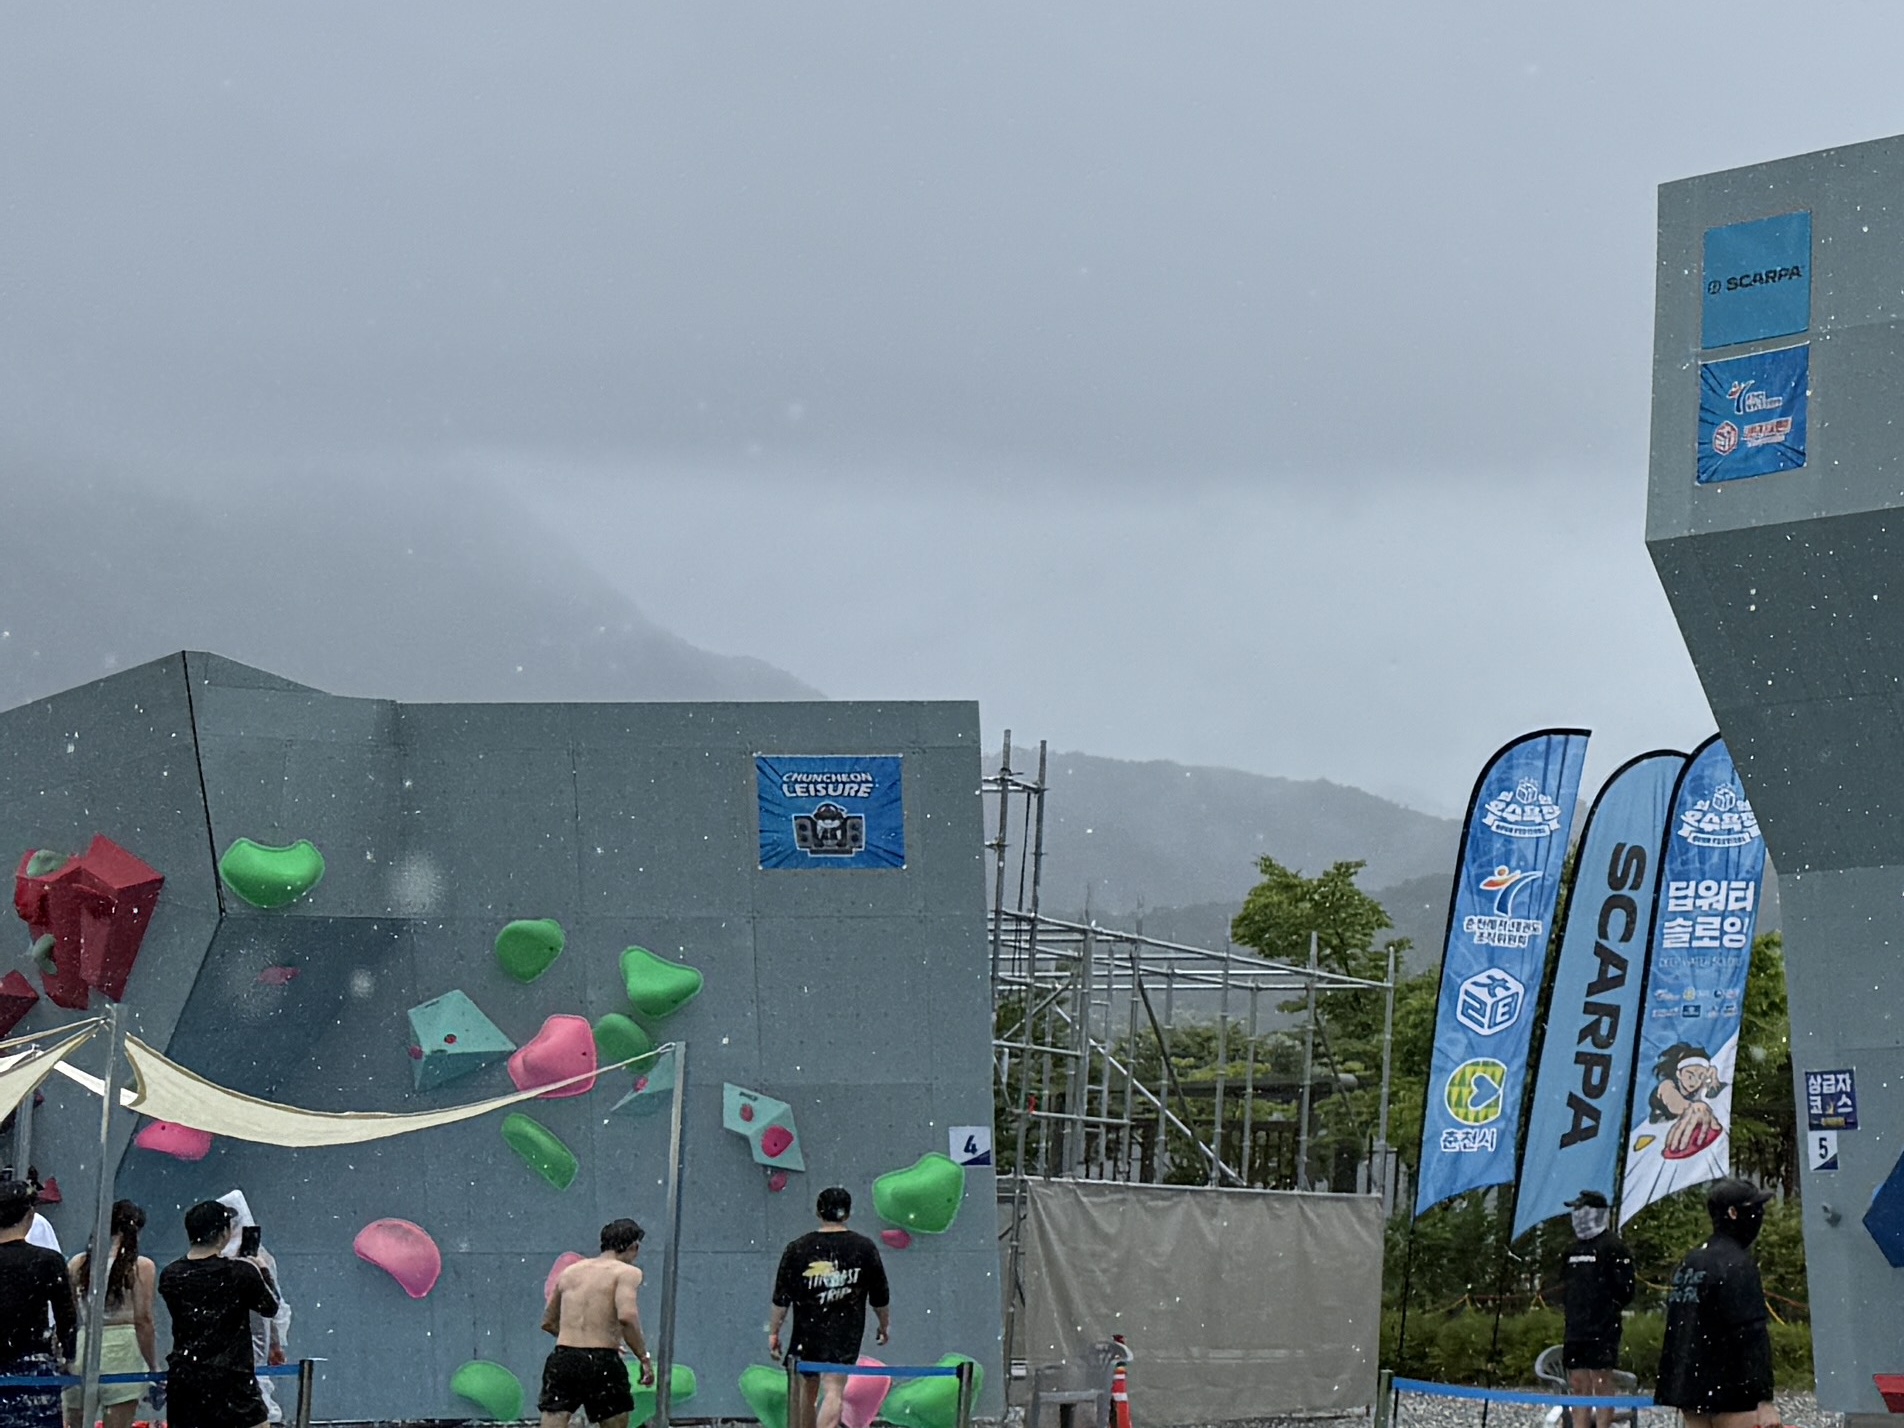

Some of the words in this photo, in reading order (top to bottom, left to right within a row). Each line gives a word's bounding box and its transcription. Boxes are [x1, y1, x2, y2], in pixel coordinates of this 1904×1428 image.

[1727, 266, 1802, 291] SCARPA
[782, 772, 873, 783] CHUNCHEON
[782, 783, 874, 797] LEISURE
[1668, 880, 1755, 912] 딥워터
[1662, 916, 1750, 948] 솔로잉
[1559, 842, 1647, 1149] SCARPA
[1808, 1073, 1852, 1094] 상급자
[963, 1134, 977, 1155] 4
[1442, 1129, 1496, 1151] 춘천시
[1818, 1137, 1829, 1160] 5
